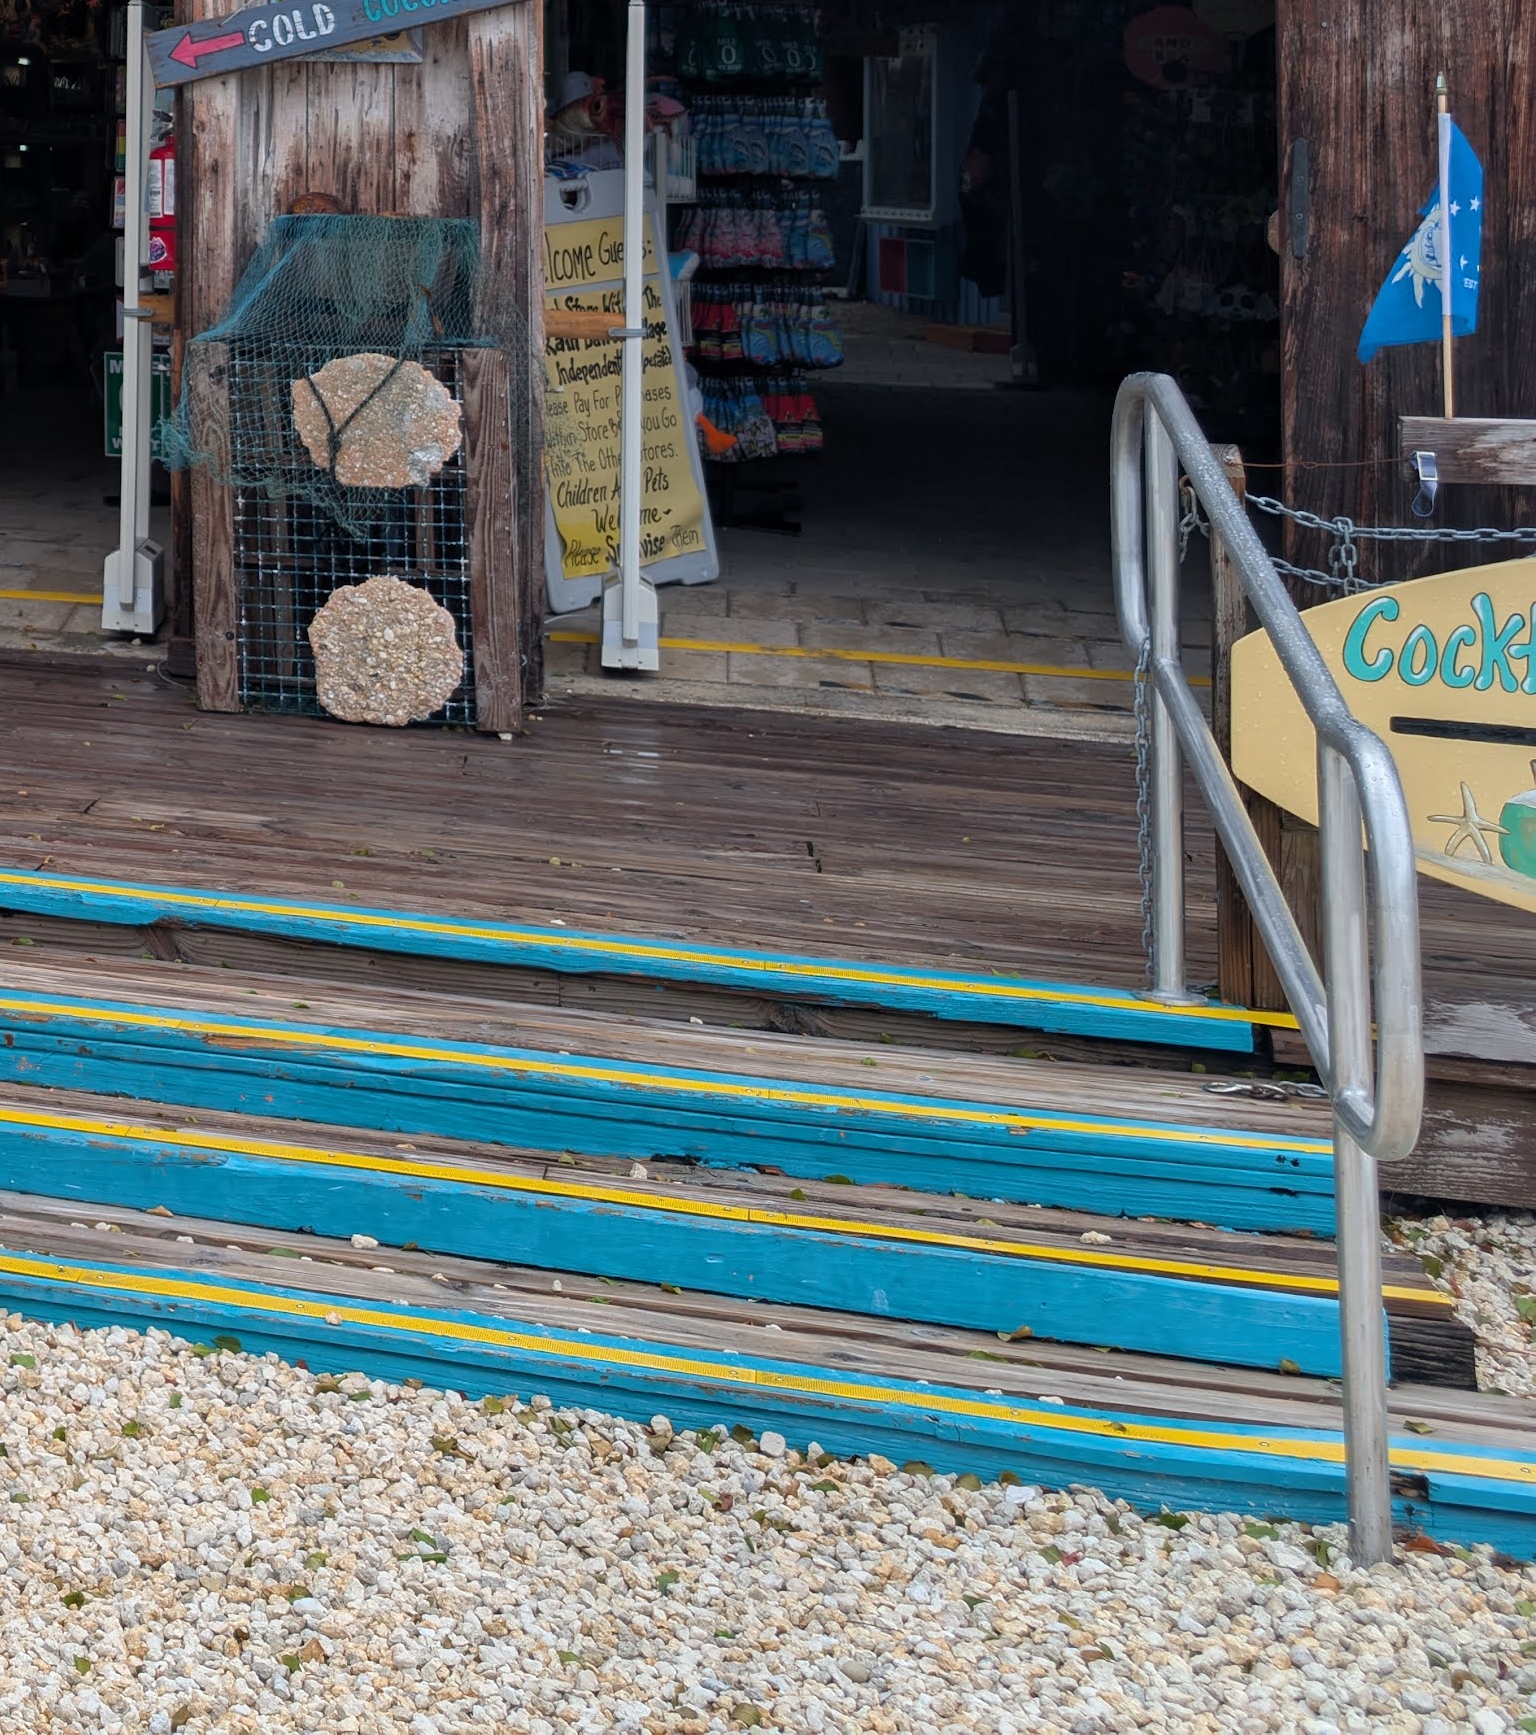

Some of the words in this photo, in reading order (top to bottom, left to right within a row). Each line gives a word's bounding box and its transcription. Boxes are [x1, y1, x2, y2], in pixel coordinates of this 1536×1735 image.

[249, 2, 335, 53] COLD
[574, 392, 591, 417] Pay
[593, 390, 609, 411] For
[578, 421, 609, 442] Store
[662, 407, 676, 428] Go
[557, 477, 607, 508] Children
[644, 467, 669, 493] Pets
[565, 539, 601, 567] Please
[671, 525, 699, 548] Them
